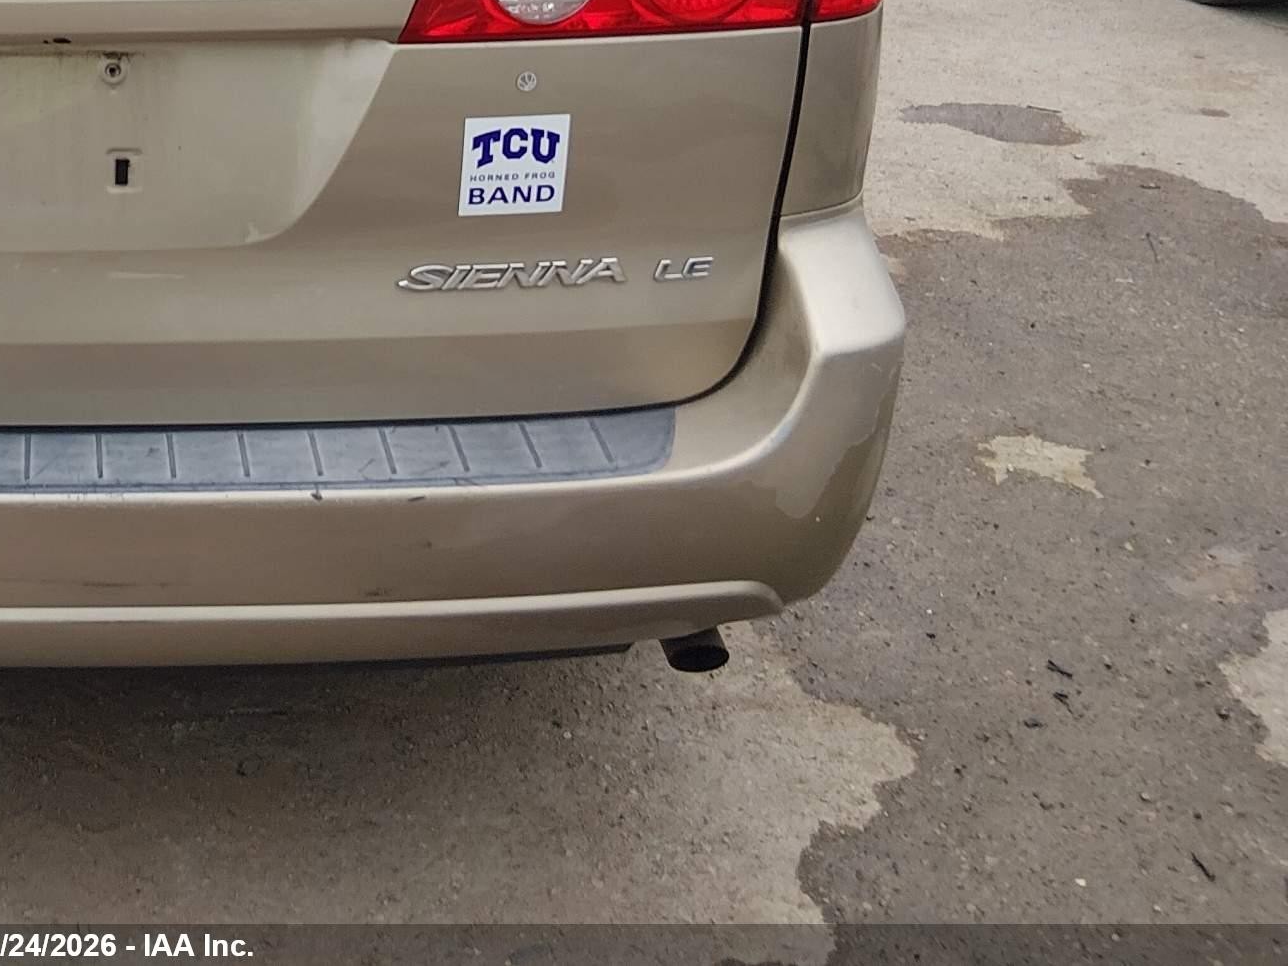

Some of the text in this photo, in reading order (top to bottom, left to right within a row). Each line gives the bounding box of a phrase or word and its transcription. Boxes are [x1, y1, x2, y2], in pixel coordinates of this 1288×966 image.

[471, 127, 561, 169] TCU
[469, 171, 556, 183] HORNED FROG
[468, 184, 556, 206] BAND
[398, 255, 714, 291] SIENNA LE
